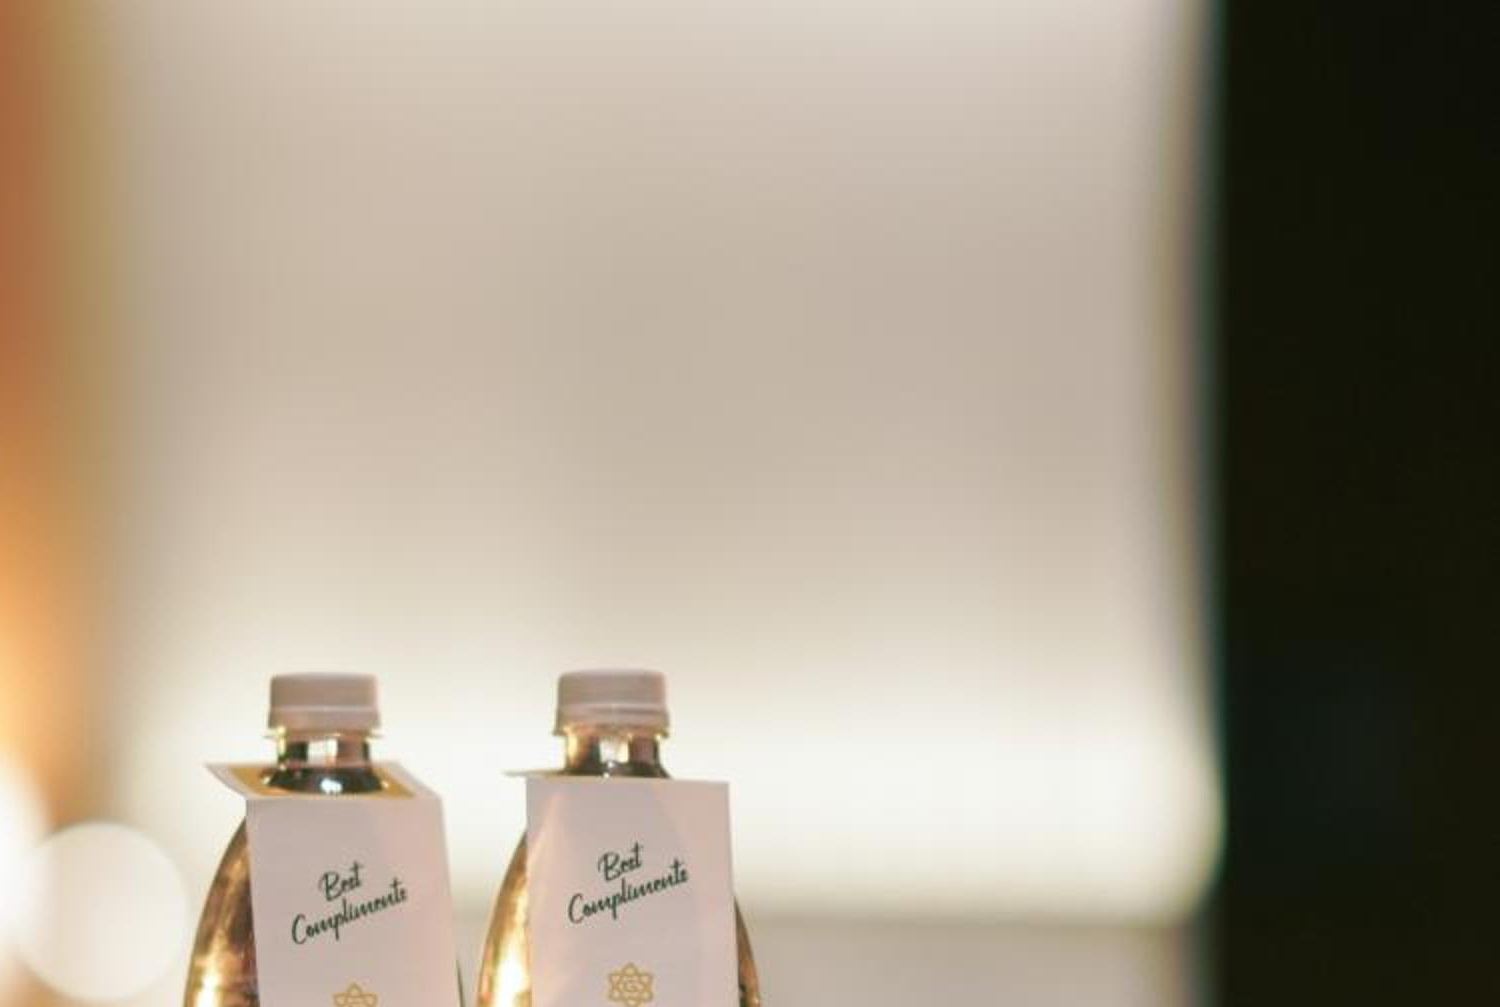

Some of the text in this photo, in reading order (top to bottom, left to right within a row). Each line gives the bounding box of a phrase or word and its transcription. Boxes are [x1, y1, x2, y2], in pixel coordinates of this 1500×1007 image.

[319, 861, 363, 901] Best
[598, 841, 643, 881] Best
[291, 878, 407, 944] Compliments
[568, 858, 688, 924] Compliments
